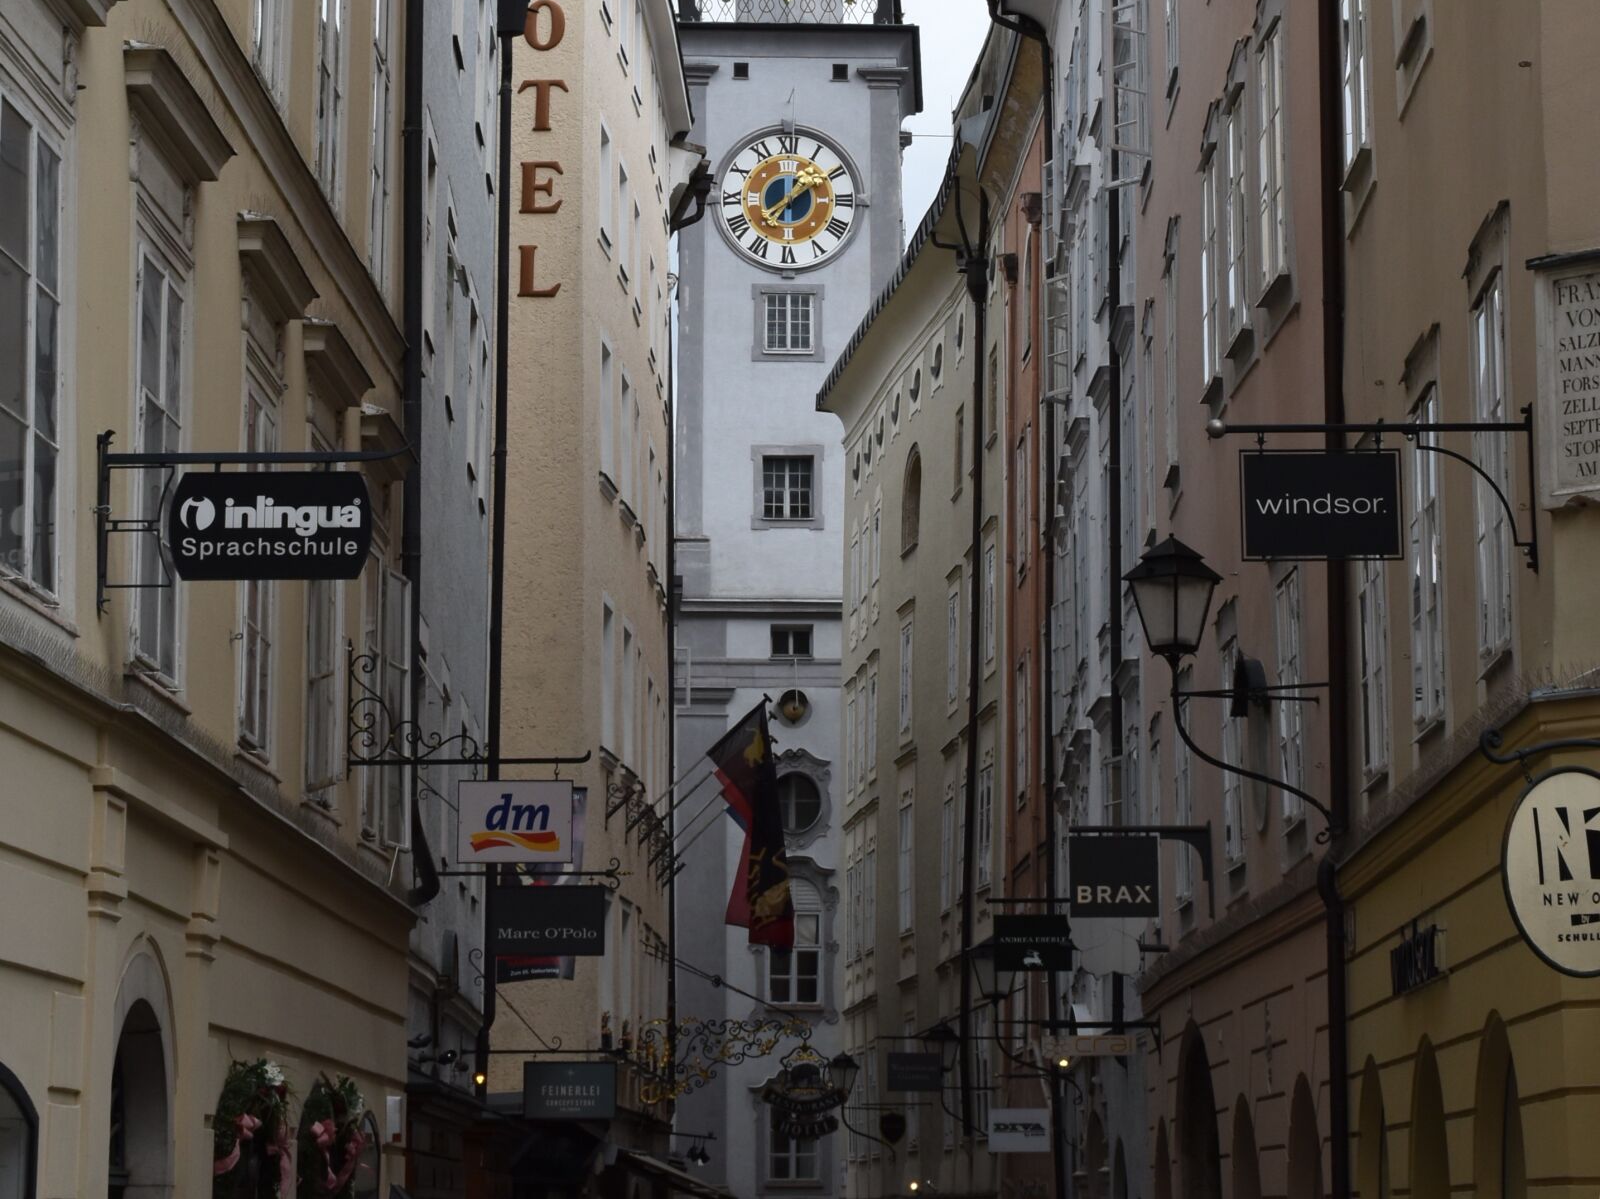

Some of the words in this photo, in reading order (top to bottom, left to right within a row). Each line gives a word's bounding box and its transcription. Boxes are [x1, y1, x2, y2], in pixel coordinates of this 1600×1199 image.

[748, 140, 773, 163] XI
[776, 136, 801, 155] XII
[810, 143, 824, 161] I
[729, 161, 752, 180] X
[723, 189, 742, 207] IX
[835, 191, 854, 209] III
[780, 245, 798, 264] VI
[811, 239, 828, 258] V
[1557, 282, 1600, 306] FRA
[1559, 332, 1600, 352] SALZ
[1576, 461, 1597, 477] AM
[1256, 493, 1387, 514] windsor.
[181, 537, 358, 560] Sprachschule
[485, 793, 550, 831] dm
[1077, 885, 1152, 904] BRAX
[1543, 893, 1579, 906] NEW
[498, 927, 540, 940] Marc
[545, 927, 597, 940] O'Polo
[1000, 936, 1034, 944] ANDREA
[1035, 936, 1066, 944] EBERLE
[541, 1085, 600, 1097] FEINERLEI
[993, 1122, 1045, 1133] DIVA
